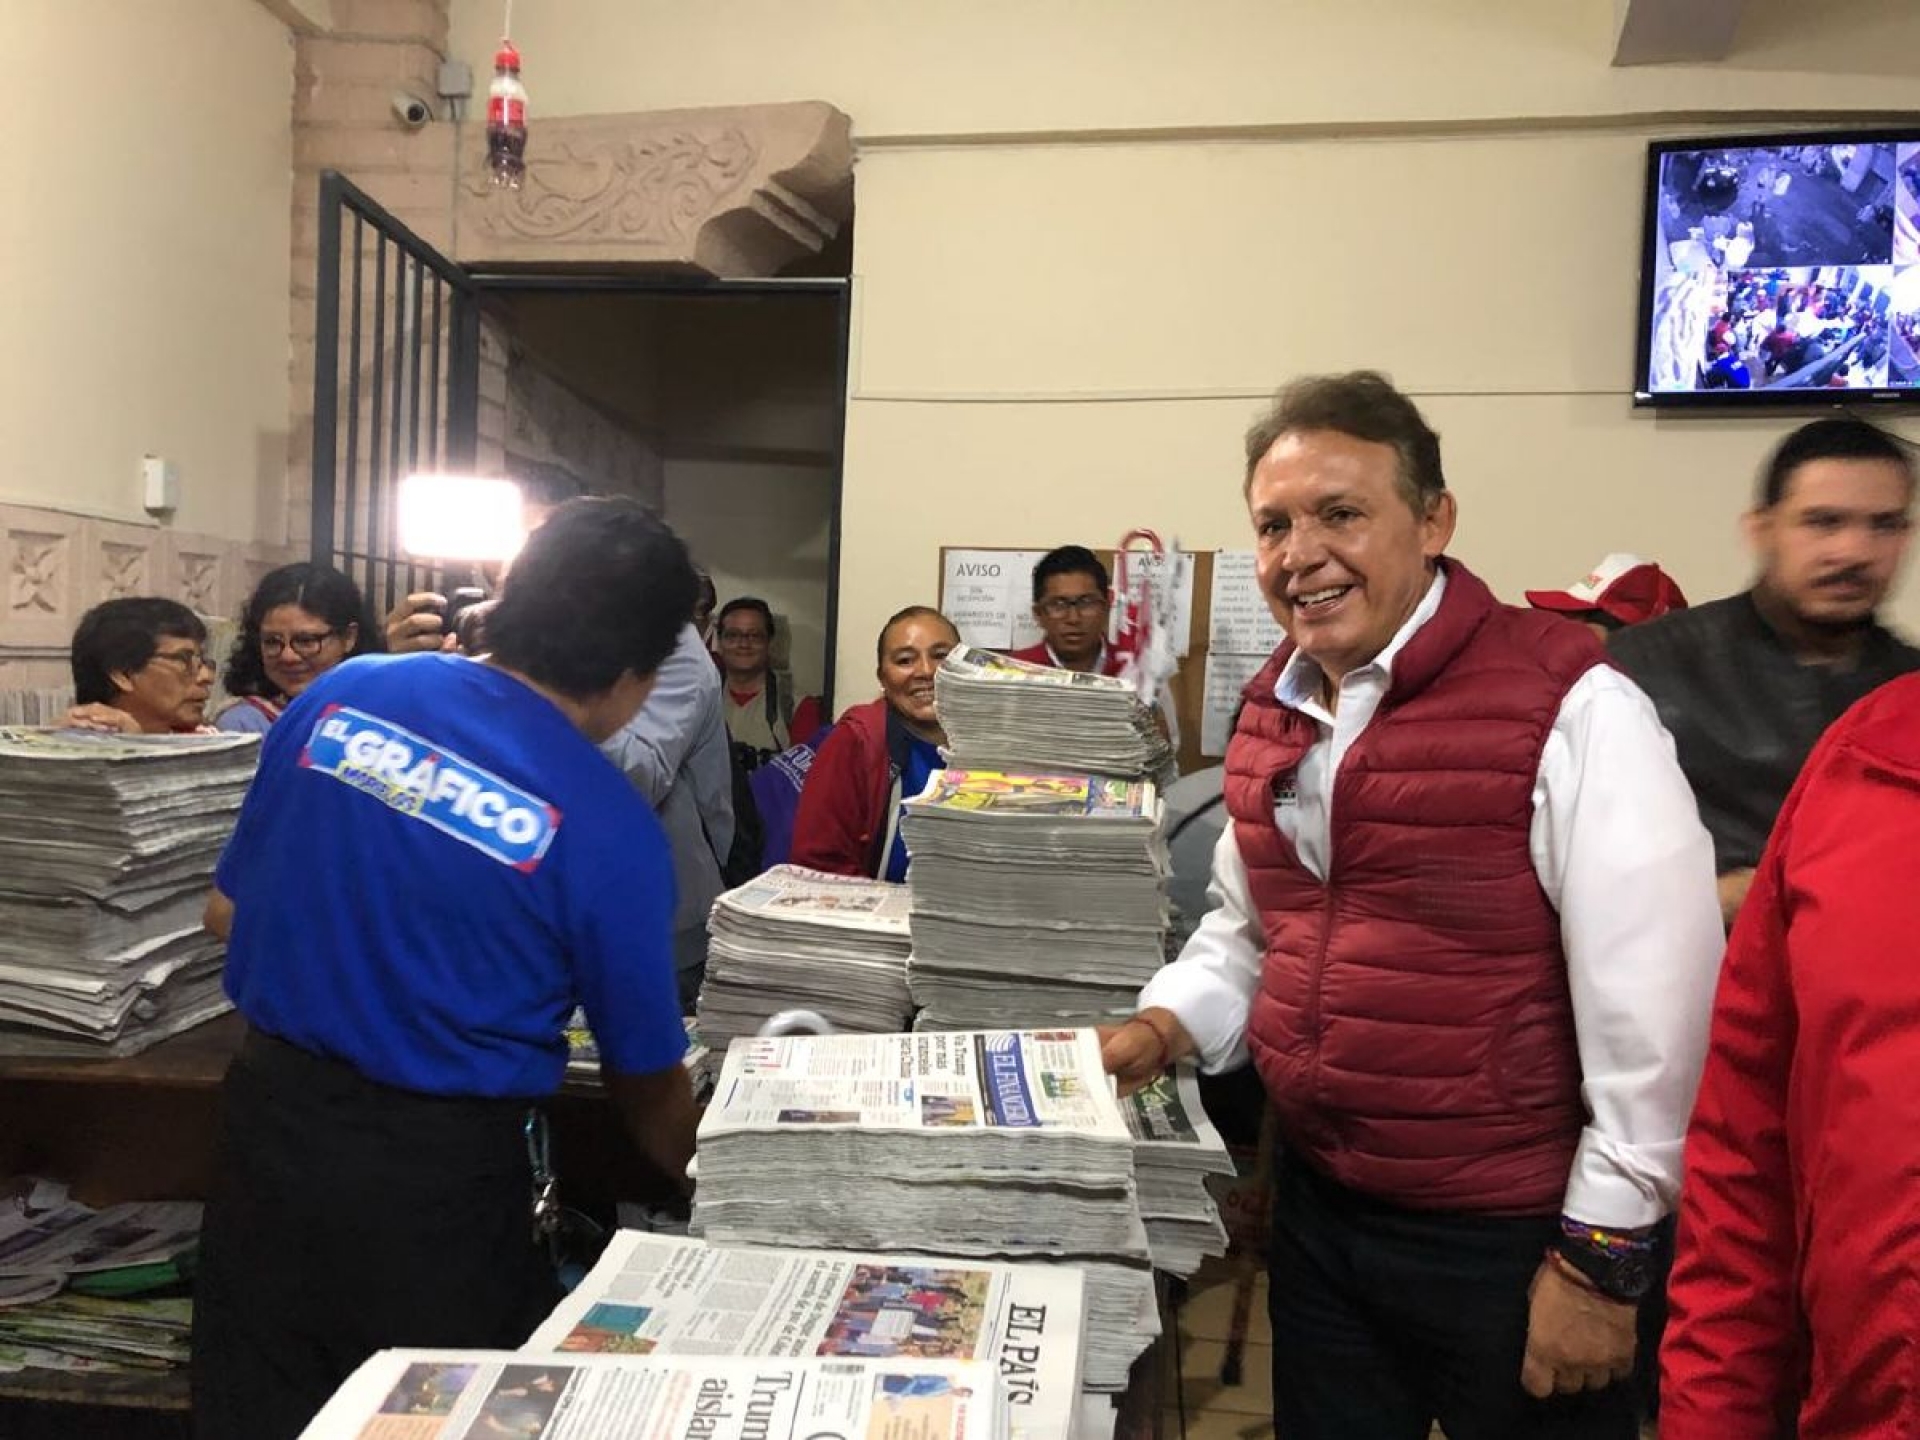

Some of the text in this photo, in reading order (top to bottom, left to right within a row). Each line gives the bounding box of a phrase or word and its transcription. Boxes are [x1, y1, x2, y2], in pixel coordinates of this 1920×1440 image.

[955, 563, 1002, 578] AVISO
[320, 718, 352, 743] EL
[343, 729, 542, 845] GRÁFICO
[1005, 1302, 1047, 1341] EL
[999, 1343, 1041, 1405] PAÍS
[739, 1371, 793, 1440] Trum
